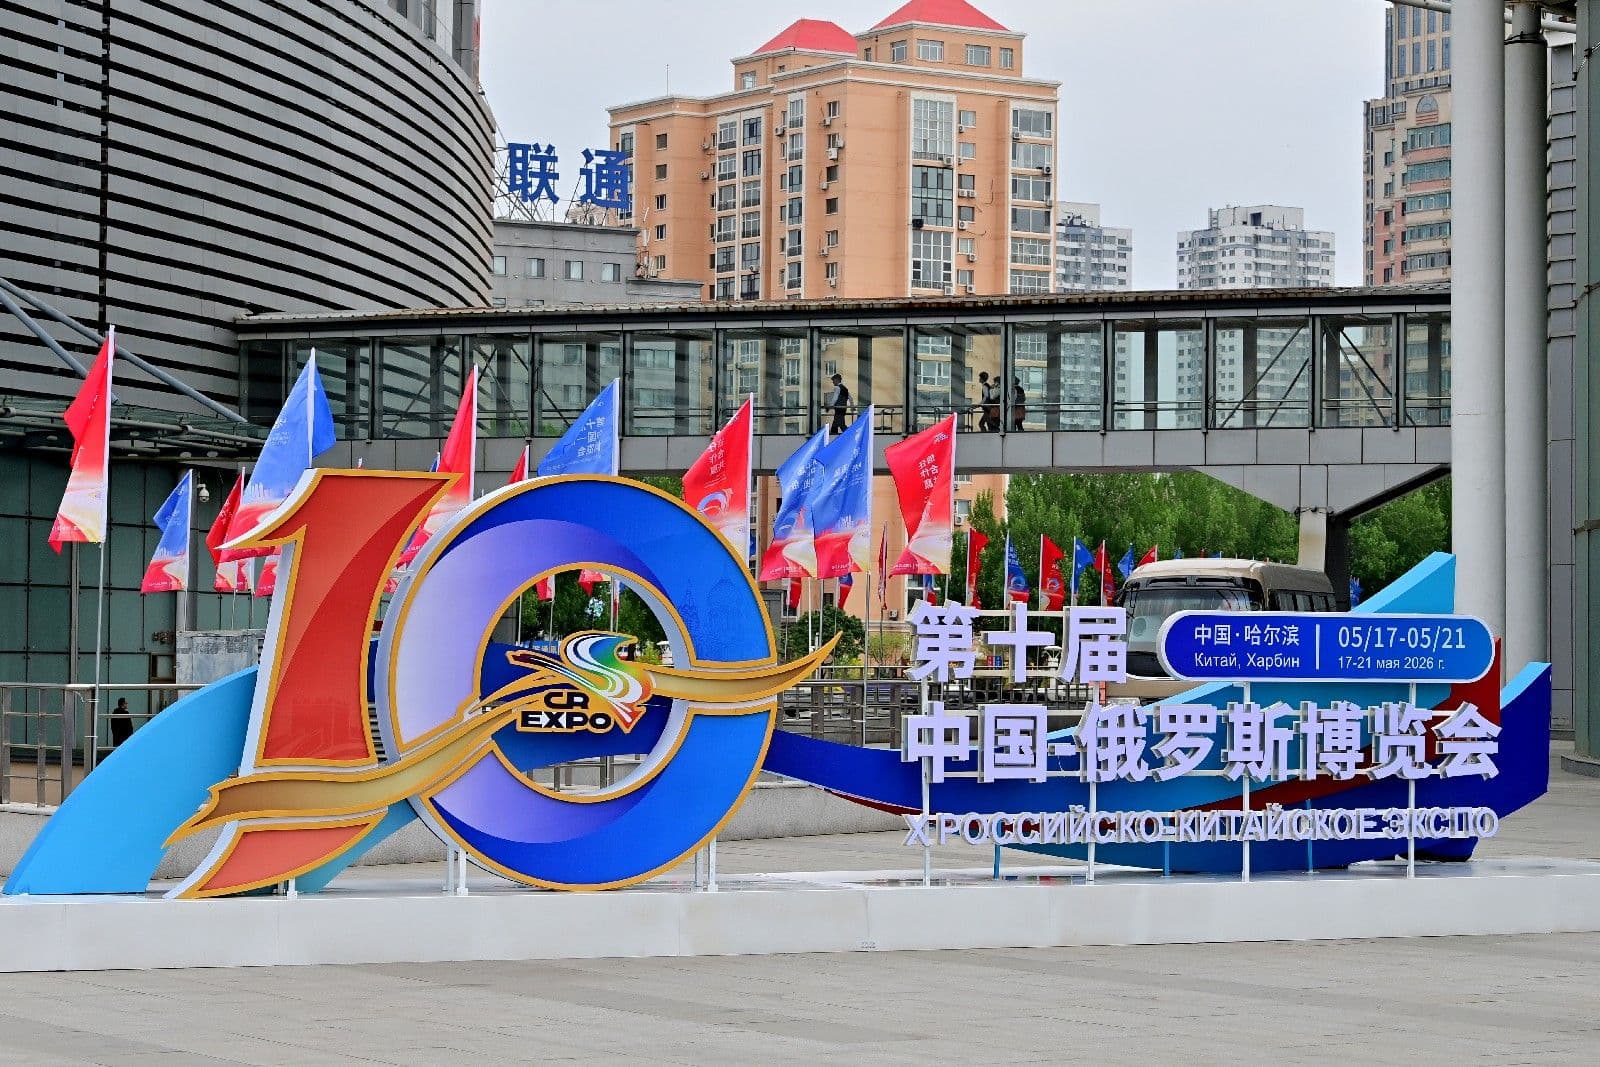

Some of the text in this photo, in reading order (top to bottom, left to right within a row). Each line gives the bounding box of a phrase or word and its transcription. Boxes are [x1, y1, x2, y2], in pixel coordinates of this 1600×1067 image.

[507, 142, 629, 209] 联通
[905, 599, 1129, 684] 第十届
[1194, 624, 1300, 646] 中国·哈尔滨
[1338, 625, 1466, 652] 05/17-05/21
[1194, 652, 1300, 670] Китай, Харбин
[1338, 656, 1445, 669] 17-21 мая 2026 г.
[544, 691, 590, 709] CR
[521, 711, 611, 729] EXPO
[936, 802, 1378, 845] РОССИЙСКО-КИТАЙСКОЕ
[1382, 806, 1500, 839] ЭКСПО
